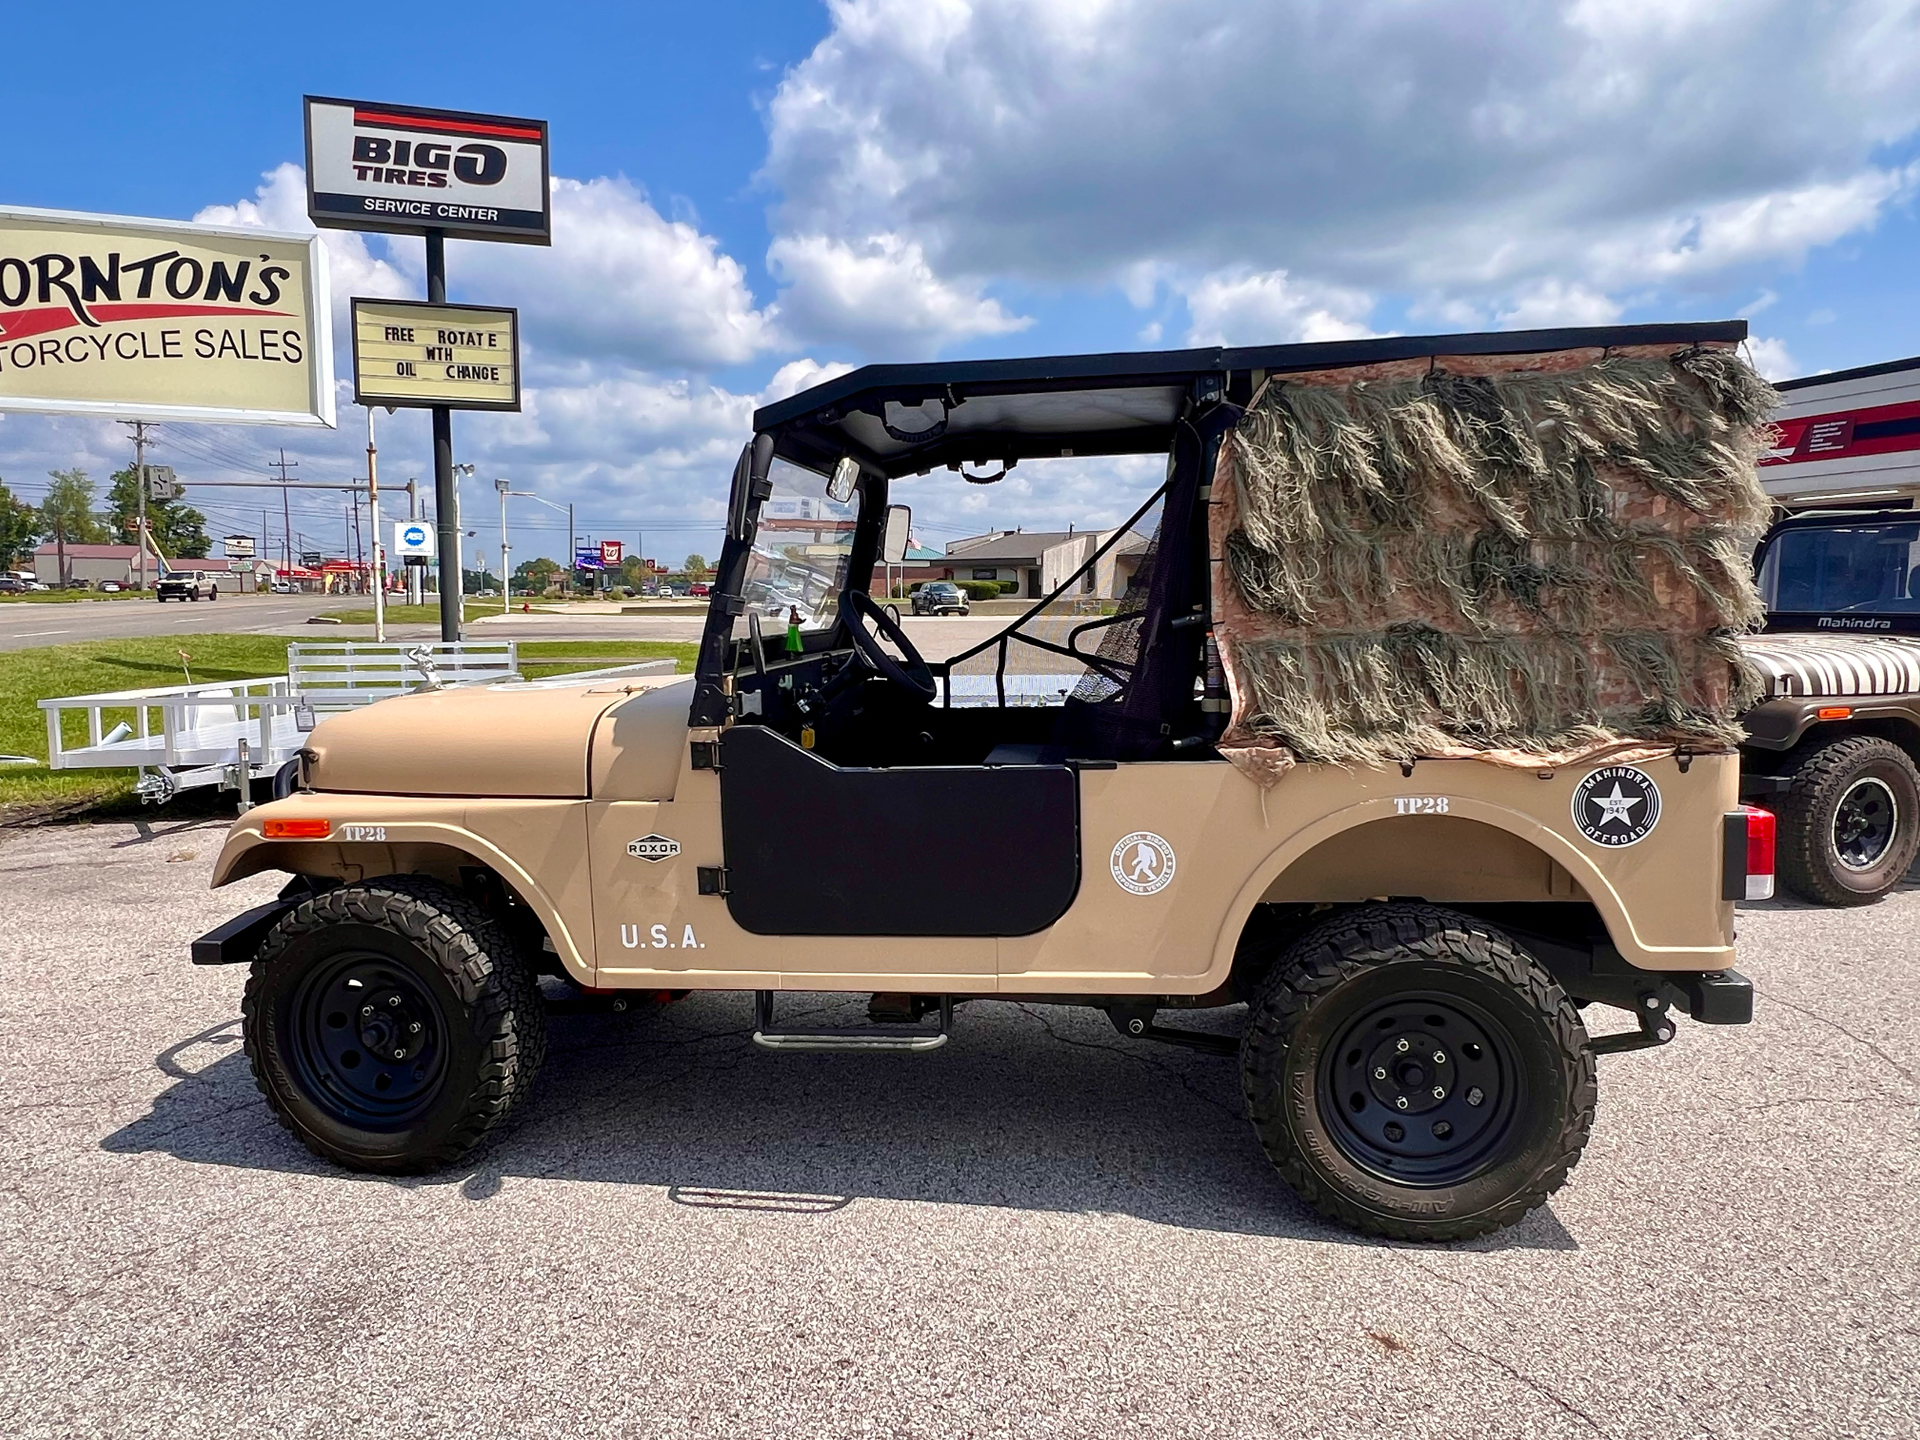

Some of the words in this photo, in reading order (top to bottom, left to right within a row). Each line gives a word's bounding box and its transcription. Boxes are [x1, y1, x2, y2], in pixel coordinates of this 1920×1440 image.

[352, 135, 452, 170] BIG
[453, 143, 508, 186] O
[352, 164, 448, 189] TIRES
[363, 198, 431, 215] SERVICE
[437, 204, 499, 222] CENTER
[194, 328, 304, 364] SALES
[384, 326, 415, 343] FREE
[438, 329, 497, 347] ROTATE
[396, 361, 417, 377] OIL
[446, 364, 499, 381] CHANGE
[1817, 617, 1892, 629] Mahindra
[1584, 768, 1650, 790] MAHINDRA
[1393, 796, 1450, 814] TP28
[1606, 806, 1626, 815] 1947
[342, 826, 387, 841] TP28
[1585, 826, 1646, 845] OFFROAD
[628, 844, 679, 853] ROXOR
[1115, 835, 1143, 857] OFFICIAL
[620, 924, 706, 949] U.S.A.
